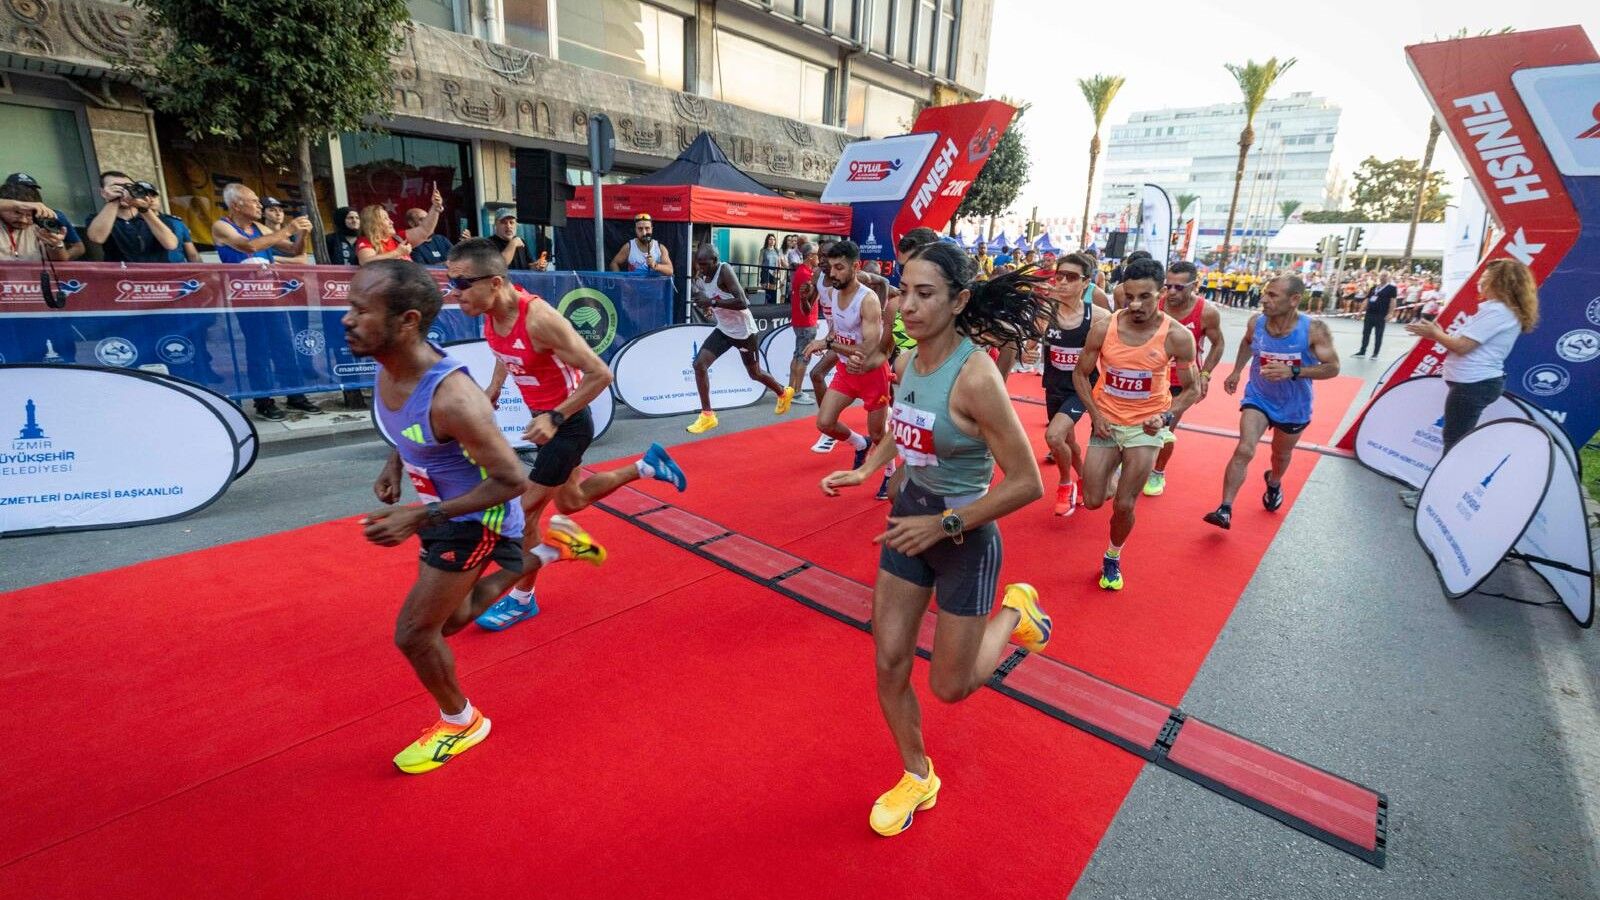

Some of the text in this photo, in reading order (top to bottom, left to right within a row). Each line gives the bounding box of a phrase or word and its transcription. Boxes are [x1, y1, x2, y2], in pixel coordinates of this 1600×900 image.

[1453, 91, 1549, 205] FINISH
[911, 137, 959, 220] FINISH
[941, 180, 971, 196] 21K
[1047, 328, 1061, 339] M
[1111, 376, 1143, 390] 1778
[12, 440, 52, 450] İZMİR
[0, 450, 75, 465] ÜYÜKŞEHİR
[1, 464, 73, 476] ELEDİYESİ
[0, 486, 184, 505] ZMETLERİ DAİRESİ BAŞKANLIĞI
